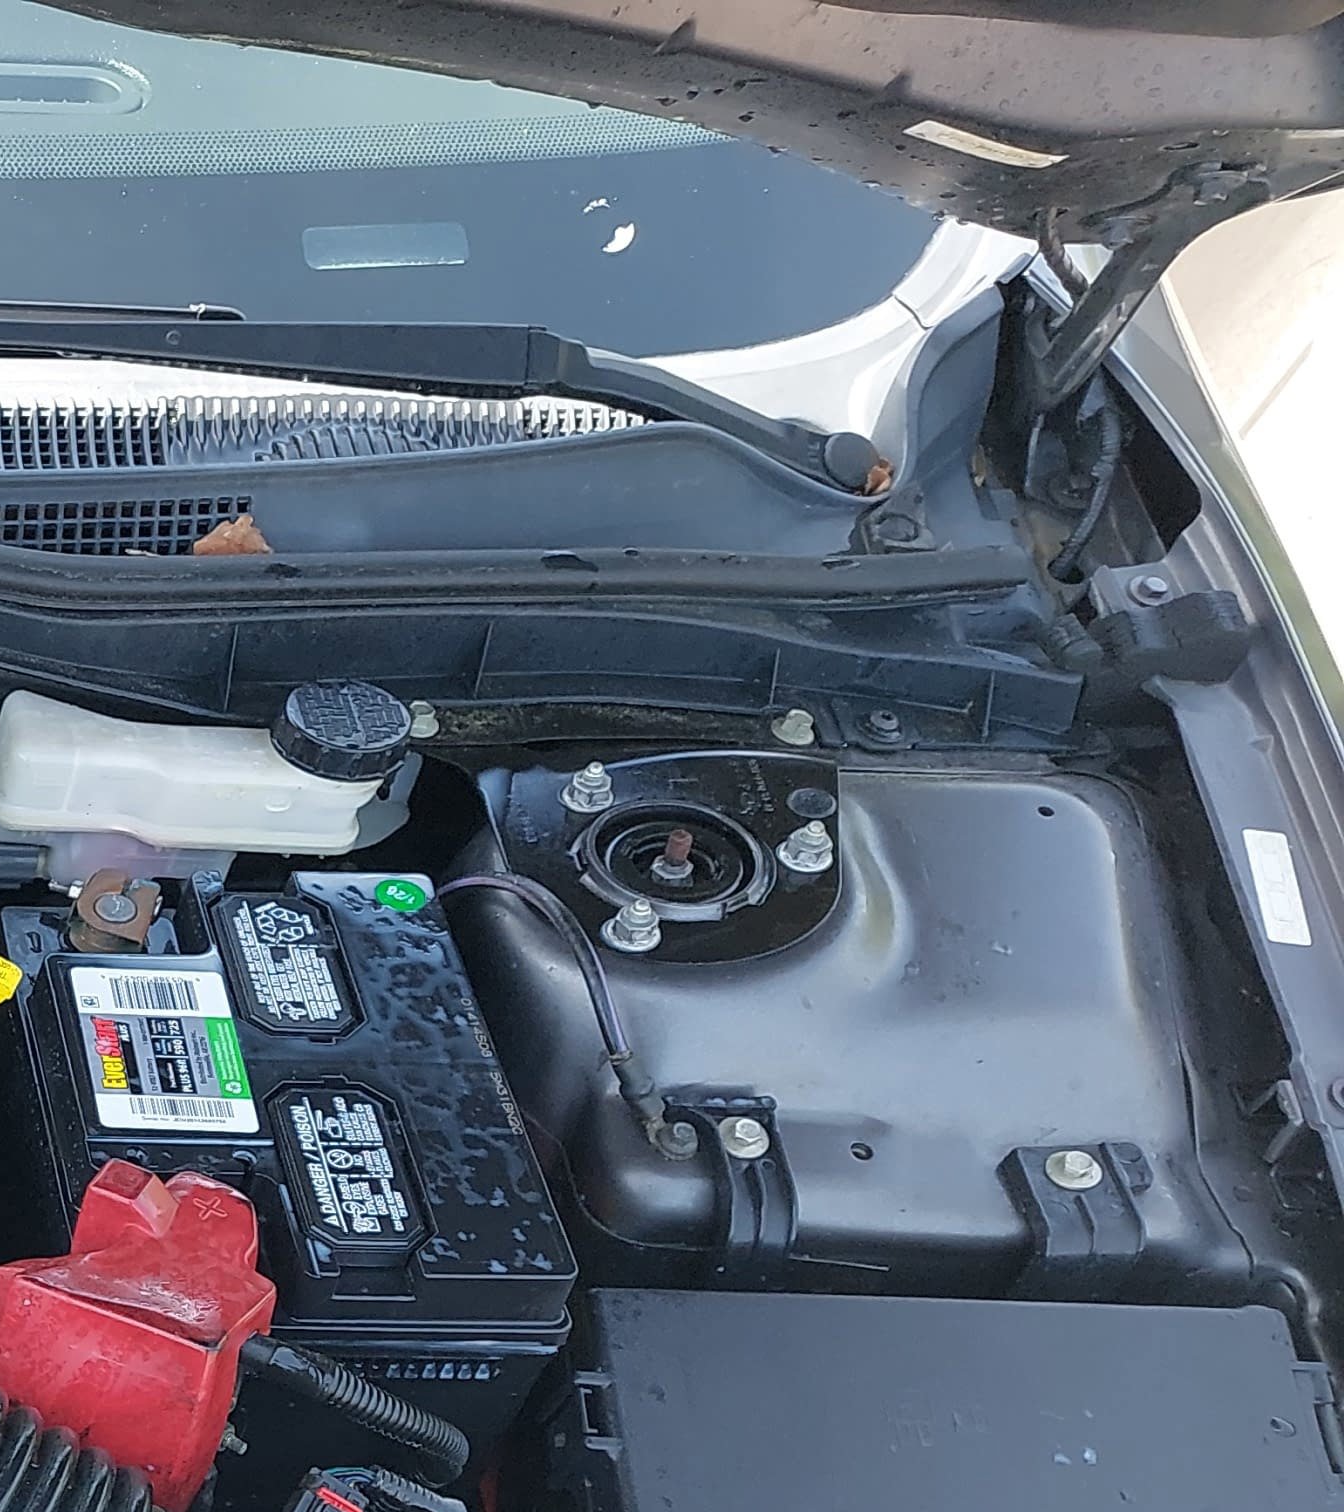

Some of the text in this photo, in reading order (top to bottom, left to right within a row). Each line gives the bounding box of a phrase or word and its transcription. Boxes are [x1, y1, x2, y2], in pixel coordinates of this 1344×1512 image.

[166, 1020, 181, 1035] 725
[91, 1016, 128, 1089] EverStart
[171, 1039, 186, 1054] 590
[178, 1074, 194, 1092] PLUS
[289, 1105, 317, 1150] POISON
[308, 1163, 336, 1213] DANGER
